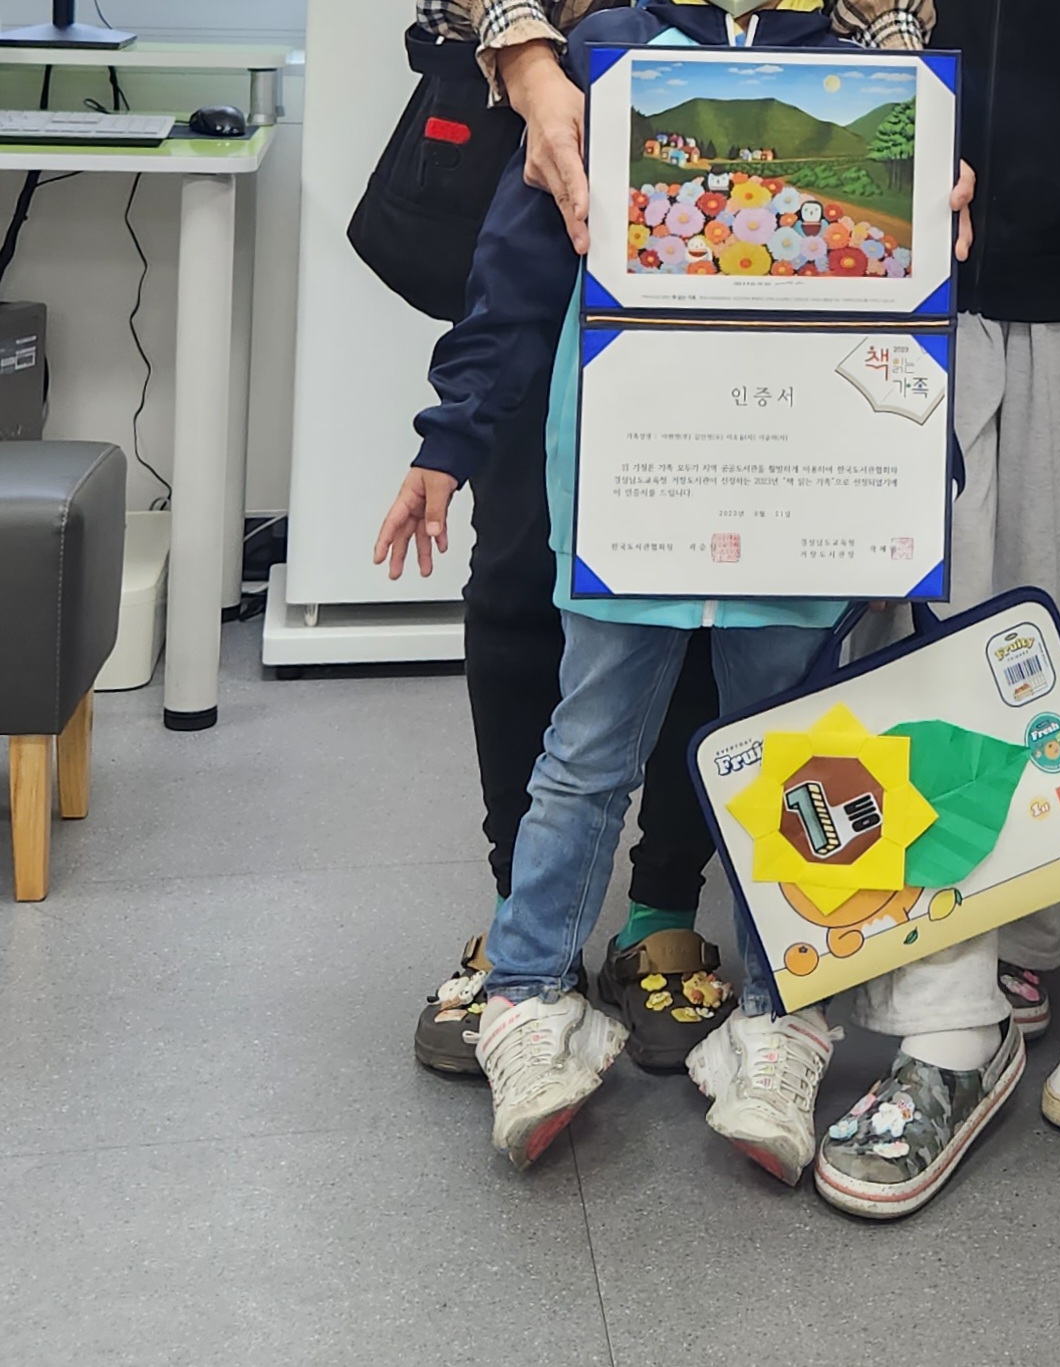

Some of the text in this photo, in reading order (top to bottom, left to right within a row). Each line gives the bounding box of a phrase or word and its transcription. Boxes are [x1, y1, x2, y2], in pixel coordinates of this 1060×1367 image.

[865, 345, 889, 381] 책
[892, 357, 915, 374] 읽는
[892, 377, 929, 397] 가족
[731, 386, 795, 408] 인증서
[658, 464, 674, 472] 가족
[677, 464, 700, 472] 모두가
[702, 464, 718, 473] 지역
[721, 464, 765, 474] 공공도서관을
[768, 465, 799, 474] 활발하게
[614, 476, 668, 485] 경상남도교육청
[754, 477, 779, 486] 2023년
[625, 489, 656, 498] 인증서를
[719, 510, 745, 518] 2023년
[611, 543, 674, 552] 한국도서관협회장
[801, 539, 855, 547] 경상남도교육청
[800, 550, 855, 559] 거창도서관장
[994, 635, 1035, 662] Fruity
[1030, 722, 1060, 742] Fresh
[716, 738, 752, 756] EVERYDAY
[714, 740, 764, 776] Frui
